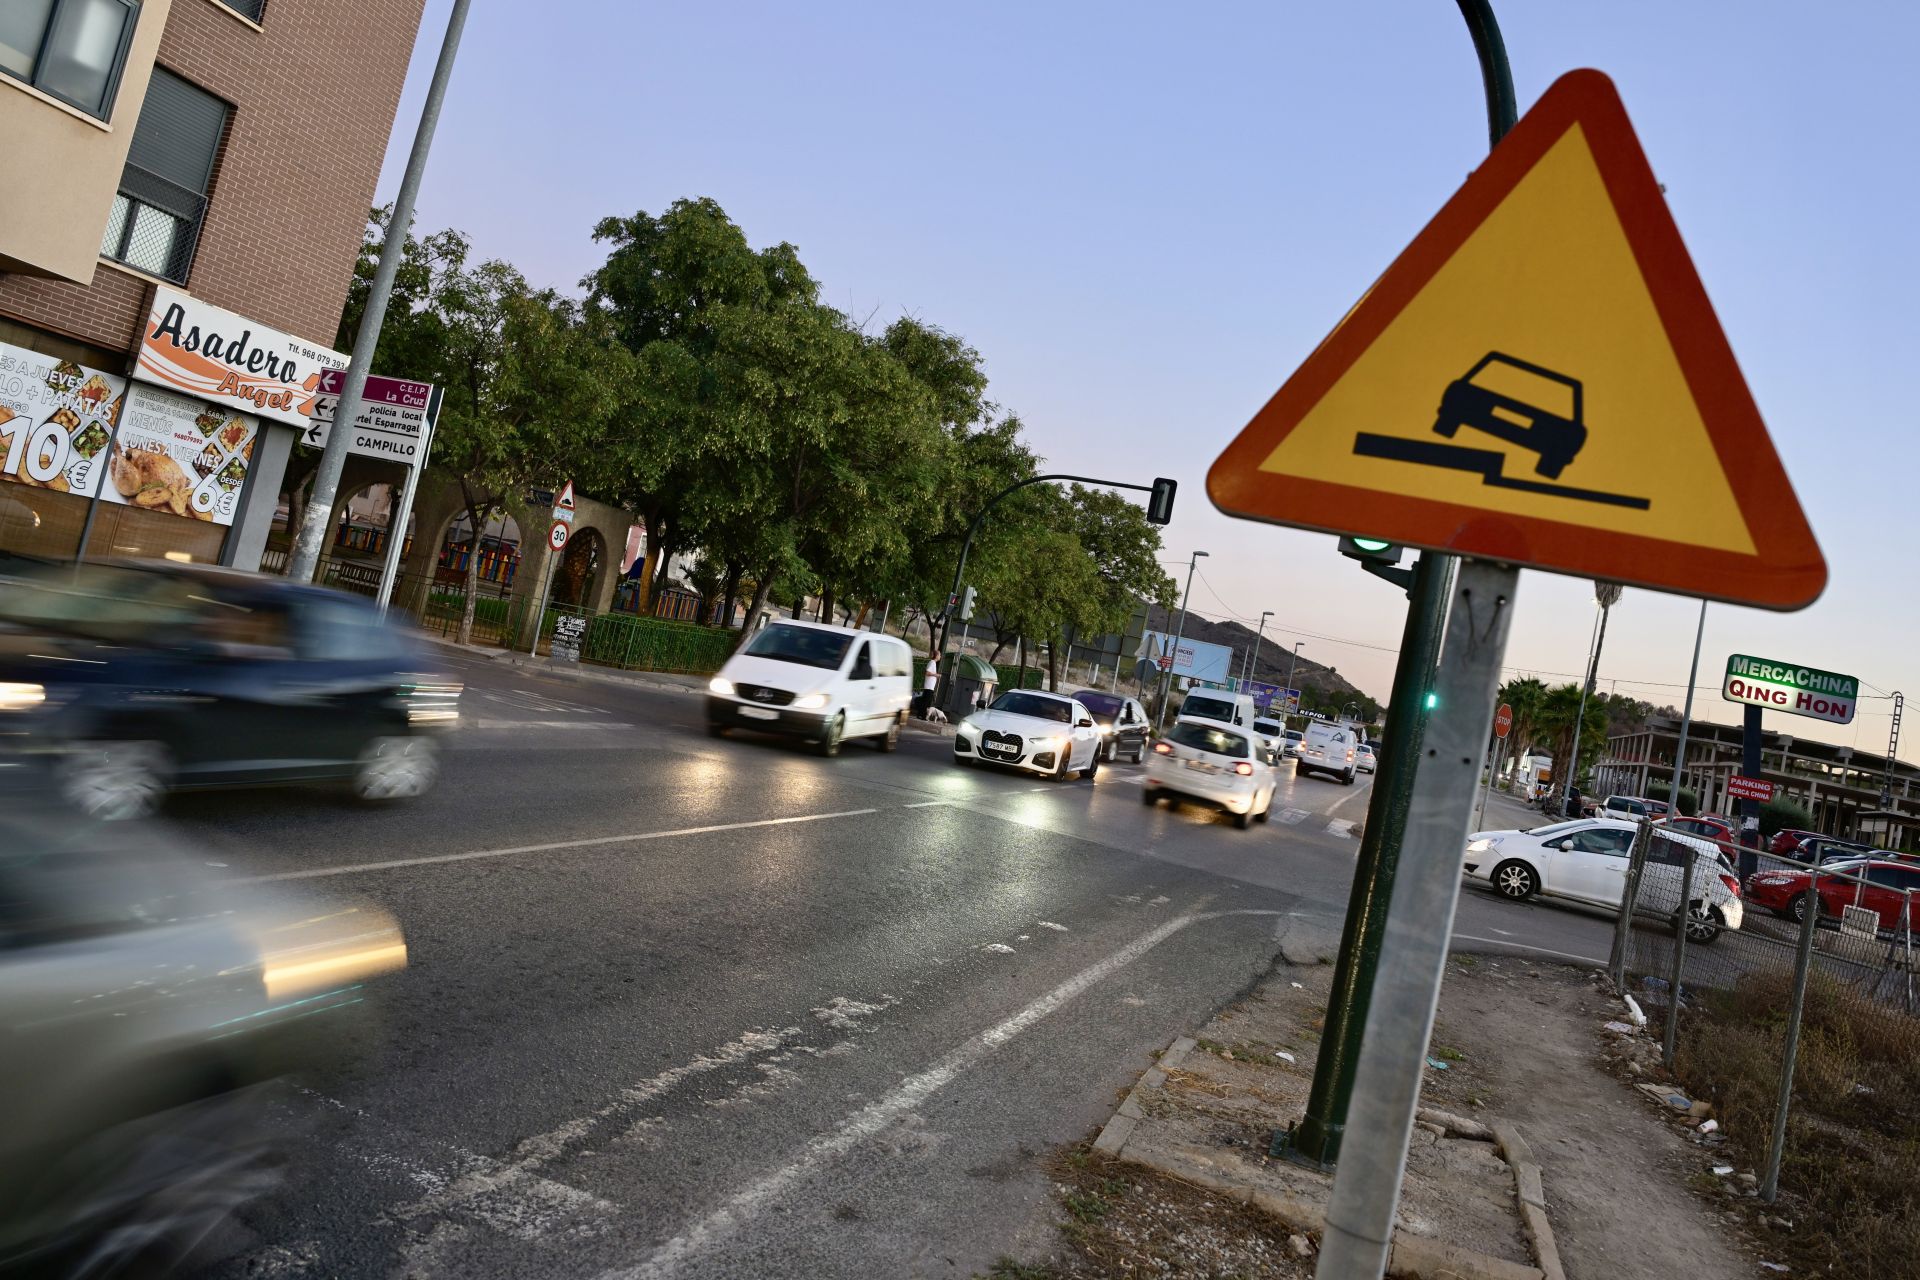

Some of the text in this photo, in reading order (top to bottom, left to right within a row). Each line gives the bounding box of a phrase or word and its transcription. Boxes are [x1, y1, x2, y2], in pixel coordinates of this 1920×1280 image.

[151, 302, 297, 383] Asadero
[302, 347, 315, 360] 968
[317, 351, 331, 365] 079
[331, 356, 345, 370] 393
[16, 361, 29, 376] A
[30, 365, 84, 390] JUEVES
[217, 372, 293, 411] Angel
[386, 391, 425, 406] La Cruz
[399, 383, 427, 395] C.E.I.P.
[41, 386, 115, 420] PATATAS
[128, 411, 173, 435] MENÚS
[355, 414, 420, 433] rtel Esparragal
[402, 410, 422, 421] local
[122, 432, 221, 469] LUNES A VIERNES
[356, 436, 415, 456] CAMPILLO
[220, 476, 242, 487] DESDE
[554, 530, 565, 542] 30
[1728, 679, 1847, 718] QING HON
[1299, 709, 1326, 719] REPSOL
[1498, 716, 1511, 726] STOP
[1728, 786, 1770, 800] MERCA CHINA
[1730, 777, 1771, 791] PARKING
